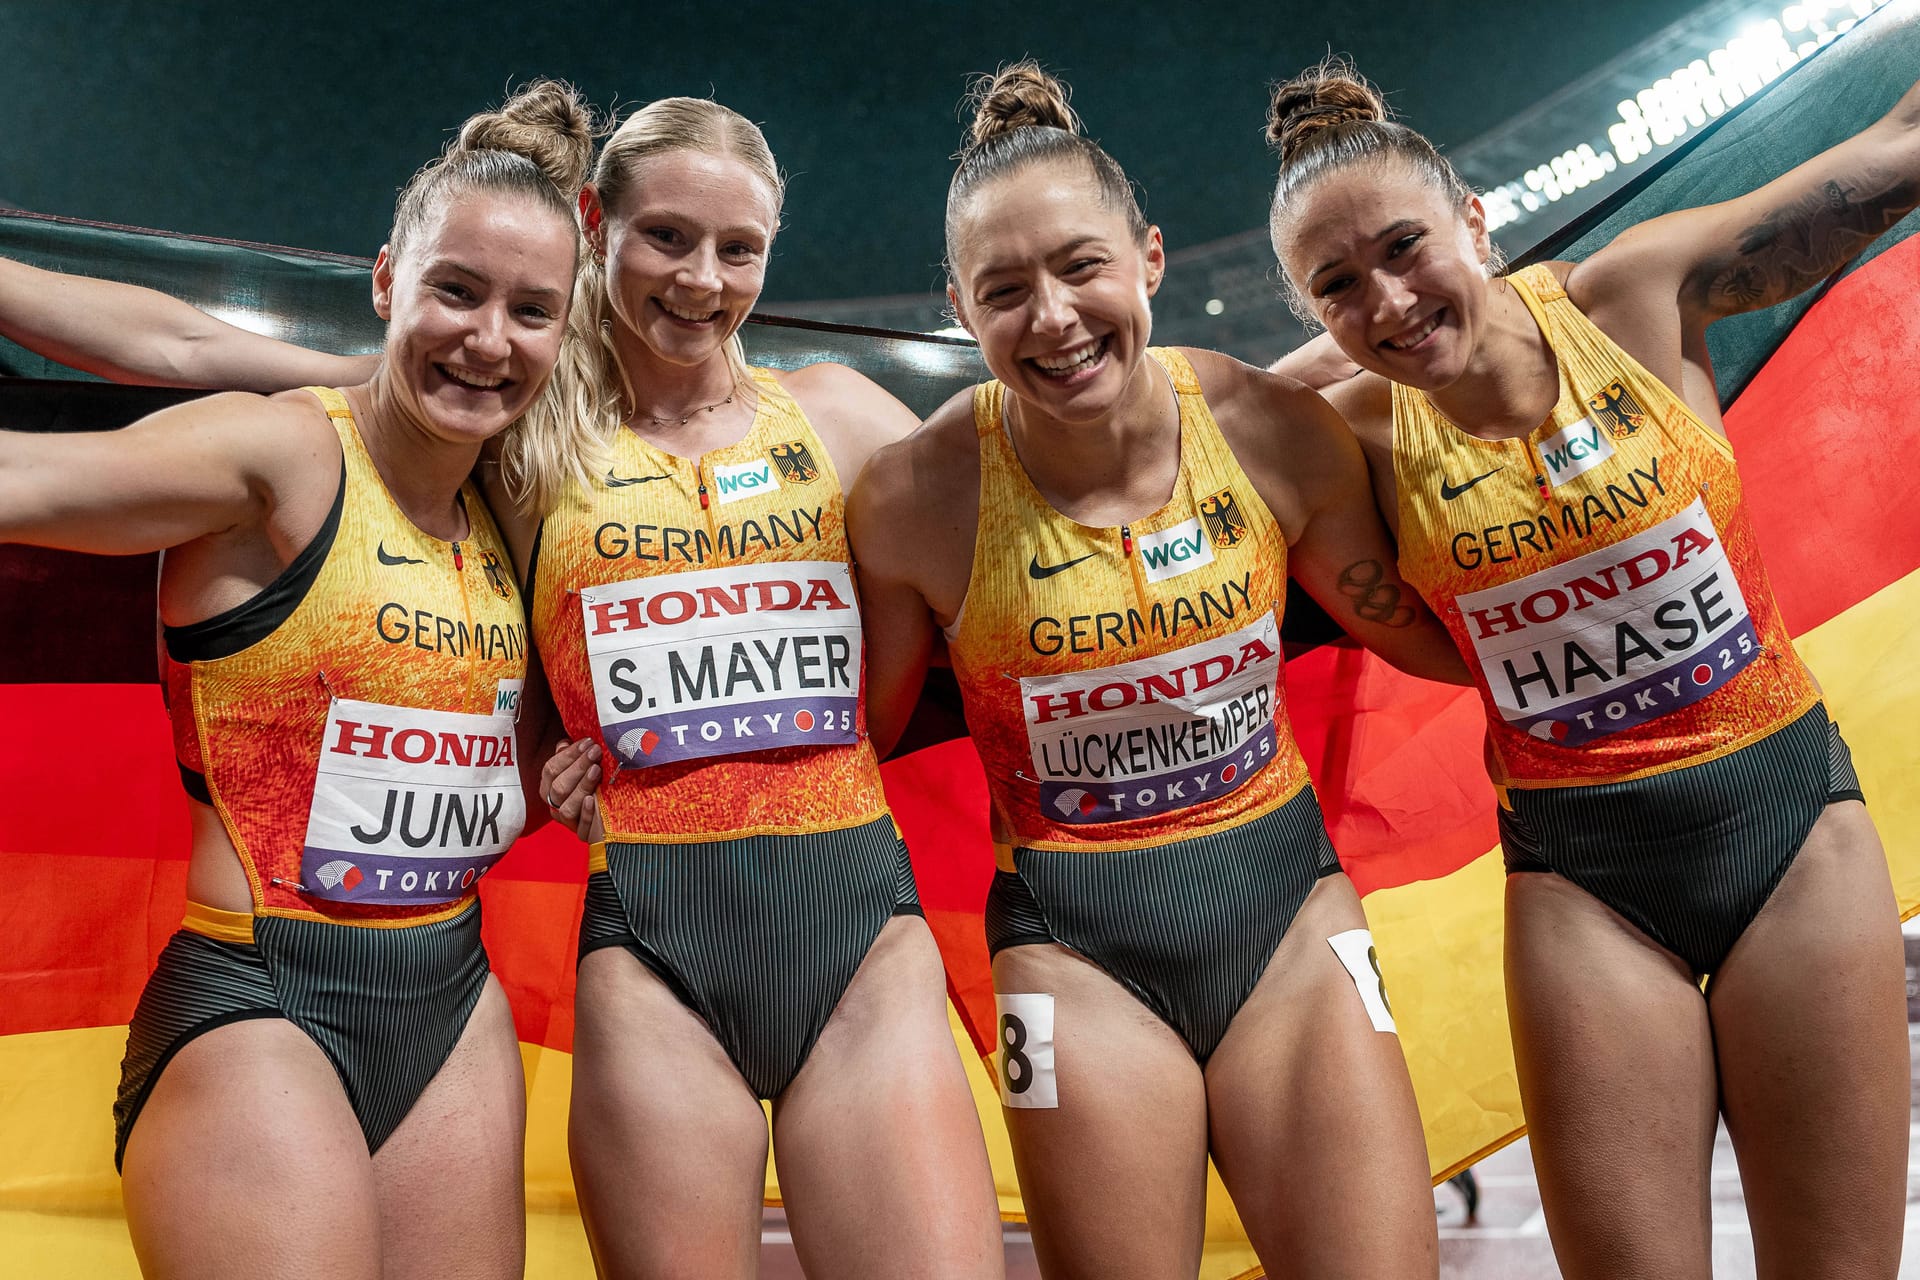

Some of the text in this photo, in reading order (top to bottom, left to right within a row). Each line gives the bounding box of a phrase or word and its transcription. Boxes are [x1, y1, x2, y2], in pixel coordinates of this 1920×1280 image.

[717, 466, 769, 494] WGV
[1545, 427, 1599, 473] WGV
[594, 507, 823, 563] GERMANY
[1452, 457, 1666, 570] GERMANY
[1142, 529, 1202, 570] WGV
[589, 579, 850, 636] HONDA
[1029, 571, 1251, 656] GERMANY
[1469, 527, 1714, 640] HONDA
[1503, 572, 1733, 709] HAASE
[497, 690, 518, 710] WG
[609, 635, 850, 714] S. MAYER
[1030, 638, 1276, 725] HONDA
[1576, 633, 1752, 730] TOKYO 25
[330, 719, 515, 767] HONDA
[671, 710, 850, 746] TOKYO 25
[1041, 683, 1269, 777] LÜCKENKEMPER
[1108, 737, 1270, 813] TOKYO 25
[350, 789, 504, 848] JUNK
[376, 867, 476, 892] TOKYO
[1000, 1013, 1033, 1094] 8
